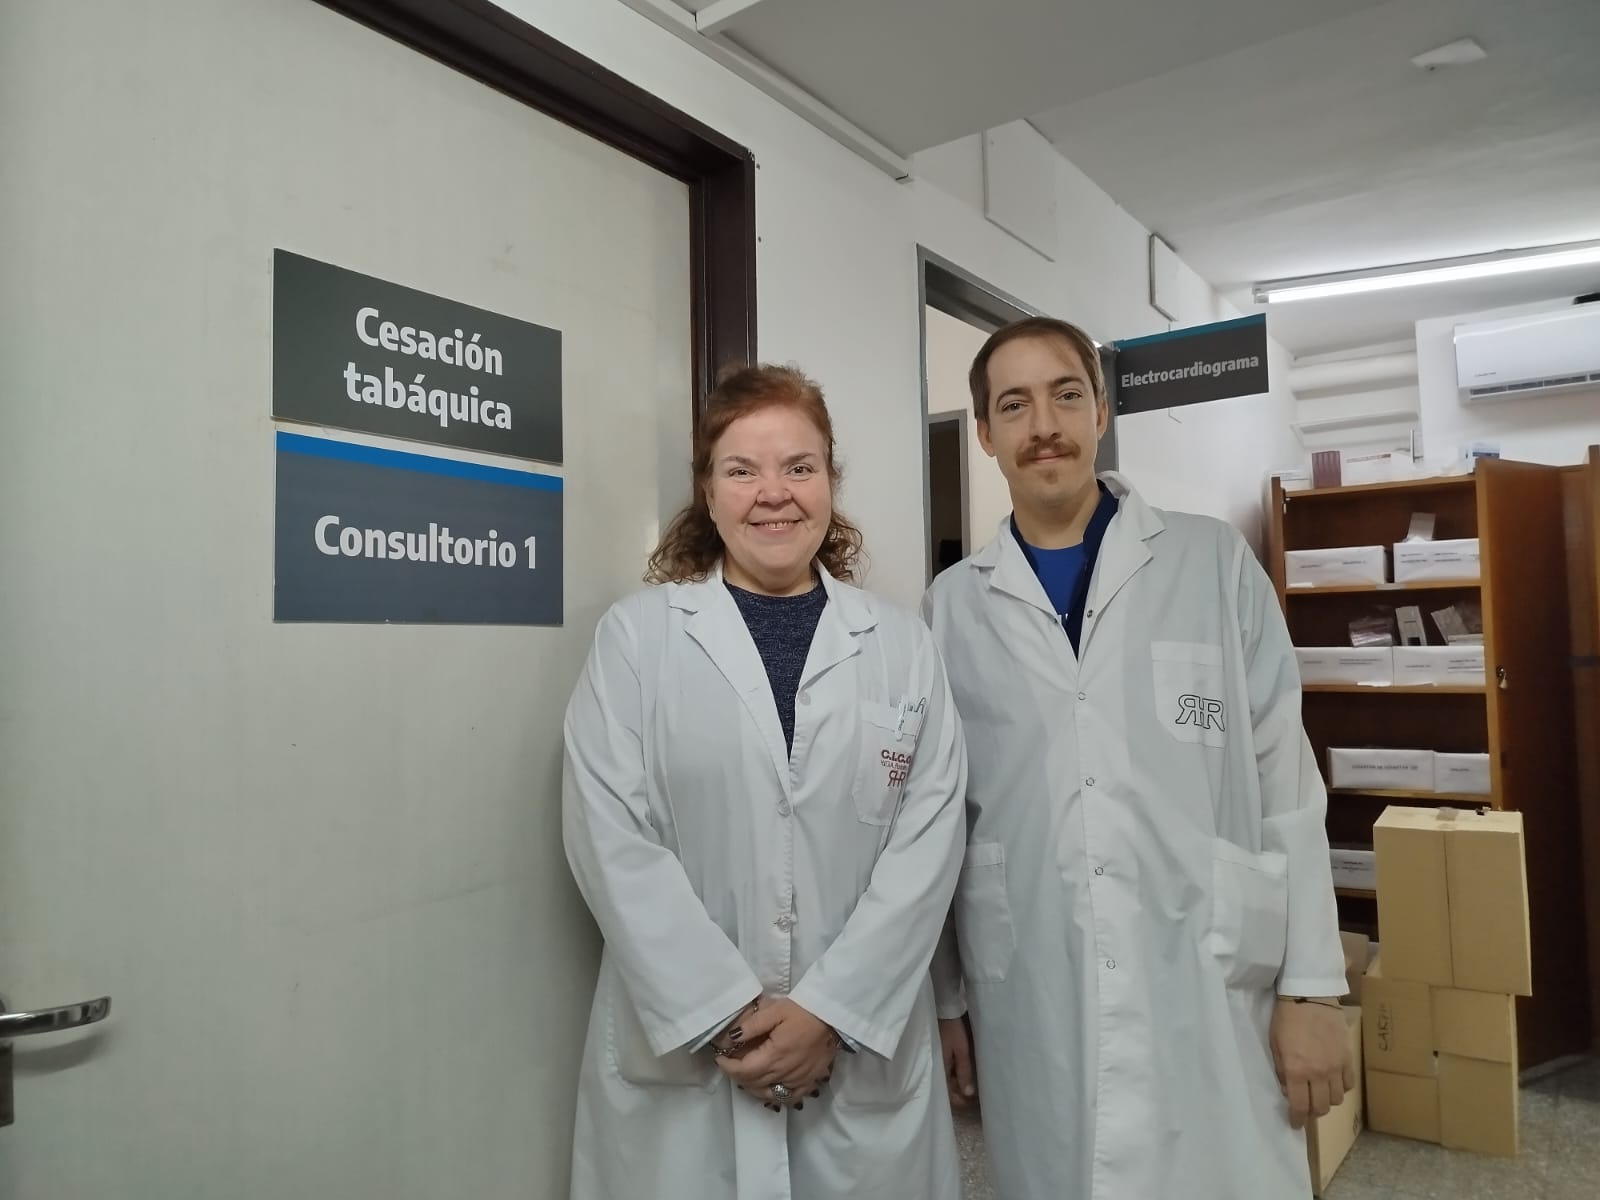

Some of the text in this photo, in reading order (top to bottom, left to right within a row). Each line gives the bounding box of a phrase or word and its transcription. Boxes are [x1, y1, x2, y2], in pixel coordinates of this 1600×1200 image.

[355, 307, 503, 376] Cesación
[1121, 355, 1260, 388] Electrocardiograma
[344, 361, 512, 430] tabáquica
[314, 515, 537, 570] Consultorio 1
